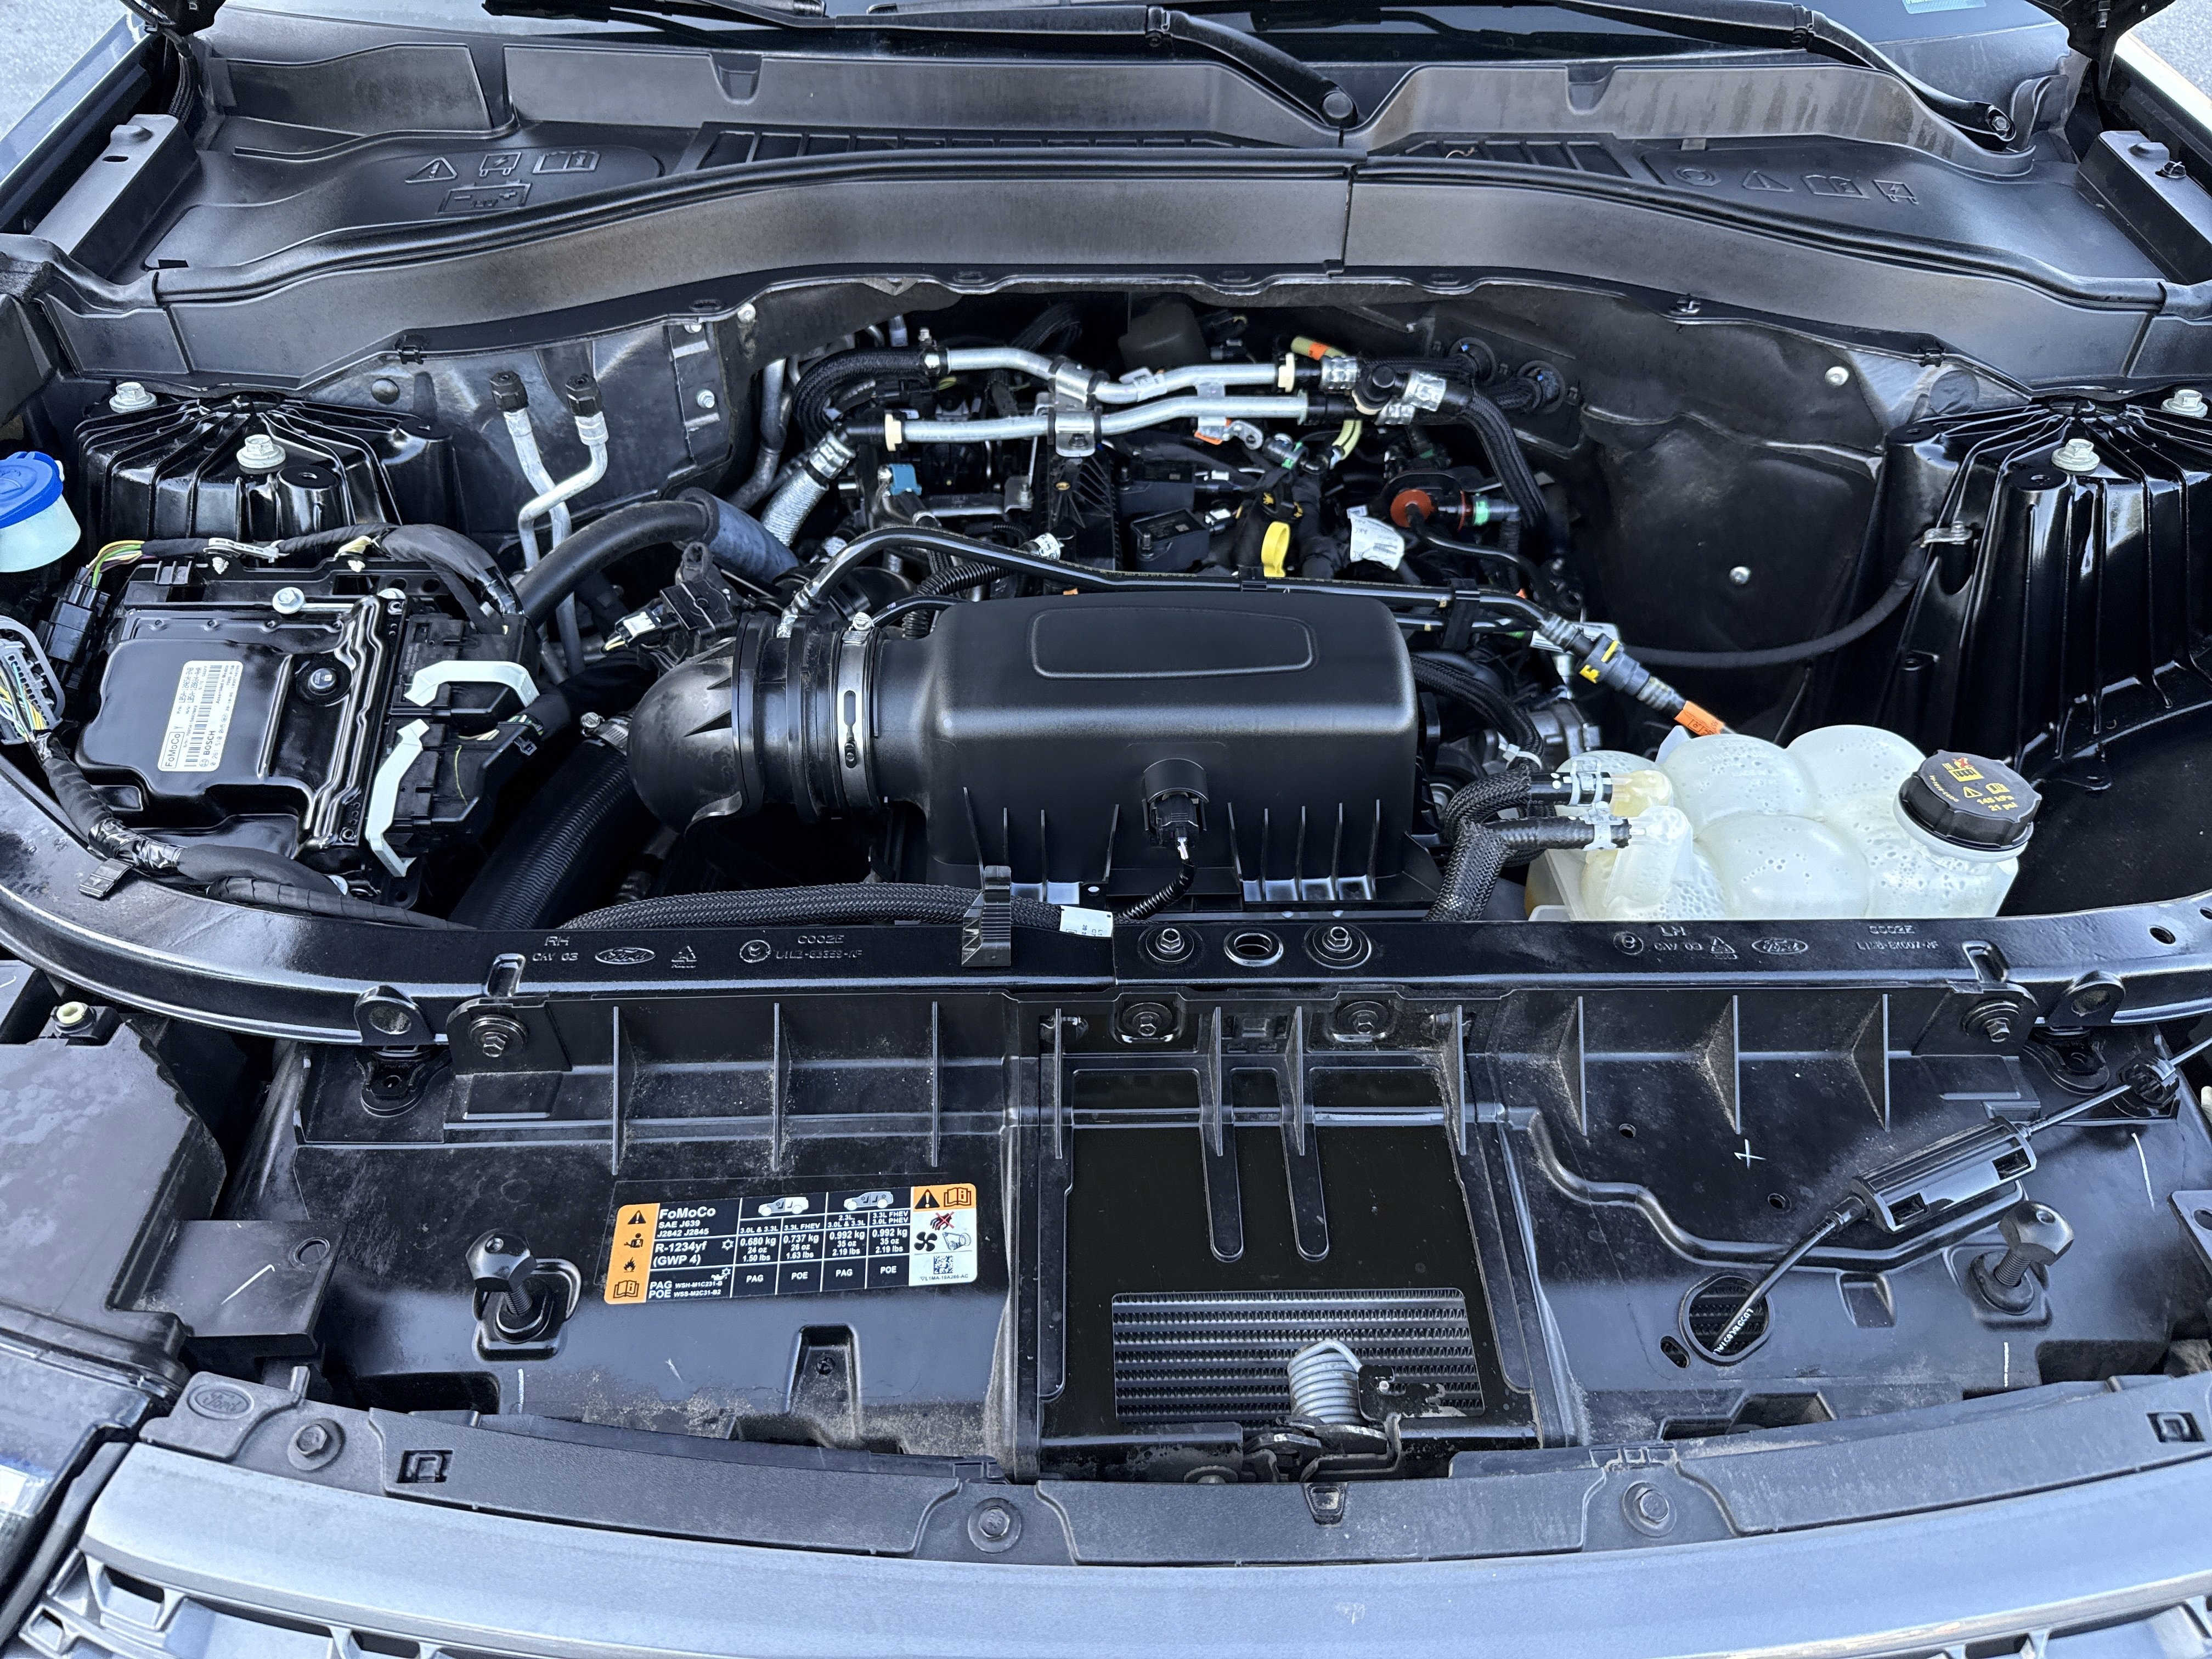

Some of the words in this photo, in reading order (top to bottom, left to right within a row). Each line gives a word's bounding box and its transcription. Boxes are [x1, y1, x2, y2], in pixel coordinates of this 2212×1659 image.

[203, 731, 216, 755] BOSCH
[165, 733, 181, 766] FoMoCo
[1977, 797, 1996, 805] 145
[2002, 802, 2018, 810] psi
[1658, 924, 1688, 936] LH
[544, 935, 571, 946] RH
[600, 948, 651, 963] Ford
[659, 1206, 716, 1220] FoMoCo
[659, 1221, 678, 1229] SAE
[679, 1220, 701, 1228] J639
[657, 1229, 682, 1238] J2842
[684, 1228, 709, 1237] J2845
[829, 1230, 852, 1240] 0.992
[854, 1229, 865, 1240] kg
[872, 1228, 895, 1238] 0.992
[896, 1227, 908, 1238] kg
[740, 1237, 763, 1246] 0.680
[765, 1236, 777, 1246] kg
[783, 1234, 806, 1244] 0.737
[808, 1233, 820, 1244] kg
[655, 1240, 708, 1254] R-1234yf
[791, 1244, 800, 1252] 26
[832, 1248, 848, 1256] 2.19
[875, 1246, 890, 1254] 2.19
[653, 1255, 687, 1268] (GWP
[689, 1254, 702, 1266] 4)
[836, 1268, 853, 1277] PAG
[880, 1265, 897, 1274] POE
[746, 1274, 764, 1283] PAG
[791, 1271, 809, 1280] POE
[650, 1280, 673, 1290] PAG
[648, 1289, 672, 1299] POE
[198, 1390, 245, 1414] Ford
